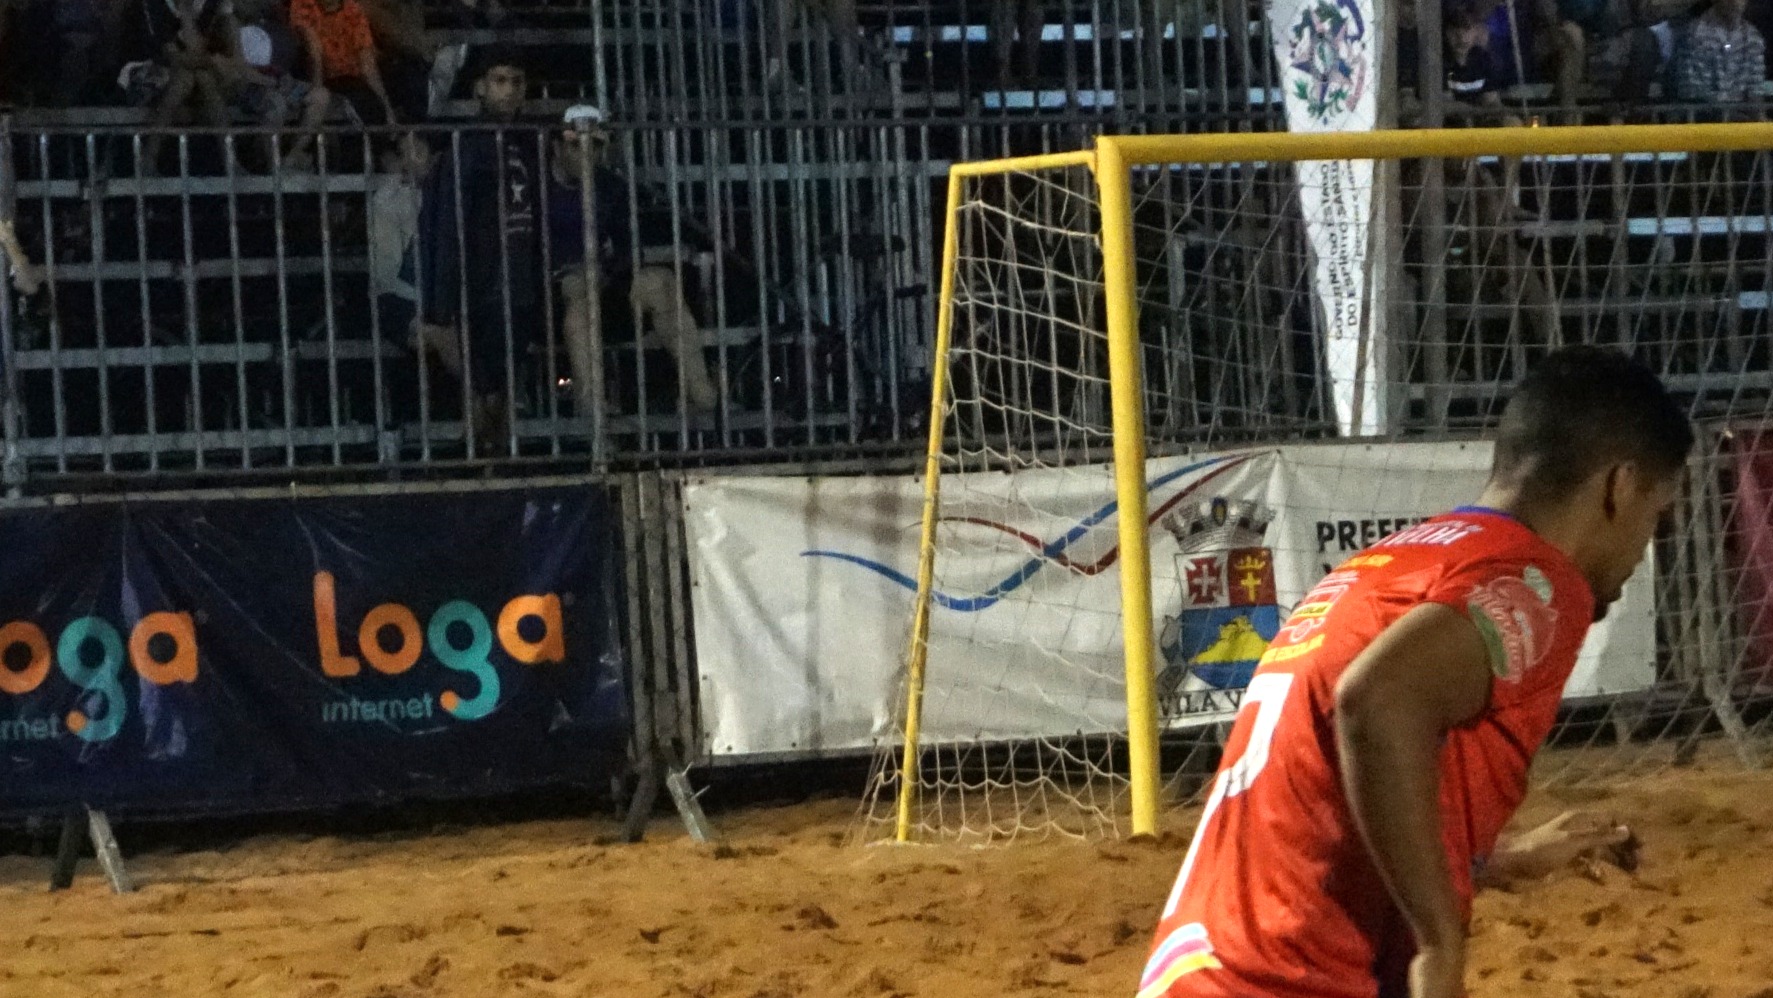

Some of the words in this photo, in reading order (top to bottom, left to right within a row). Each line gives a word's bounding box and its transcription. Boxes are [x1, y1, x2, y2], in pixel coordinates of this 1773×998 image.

[1347, 303, 1358, 327] DO
[1316, 517, 1429, 552] PREF
[313, 569, 566, 721] Loga
[0, 610, 199, 742] oga
[320, 692, 434, 723] internet
